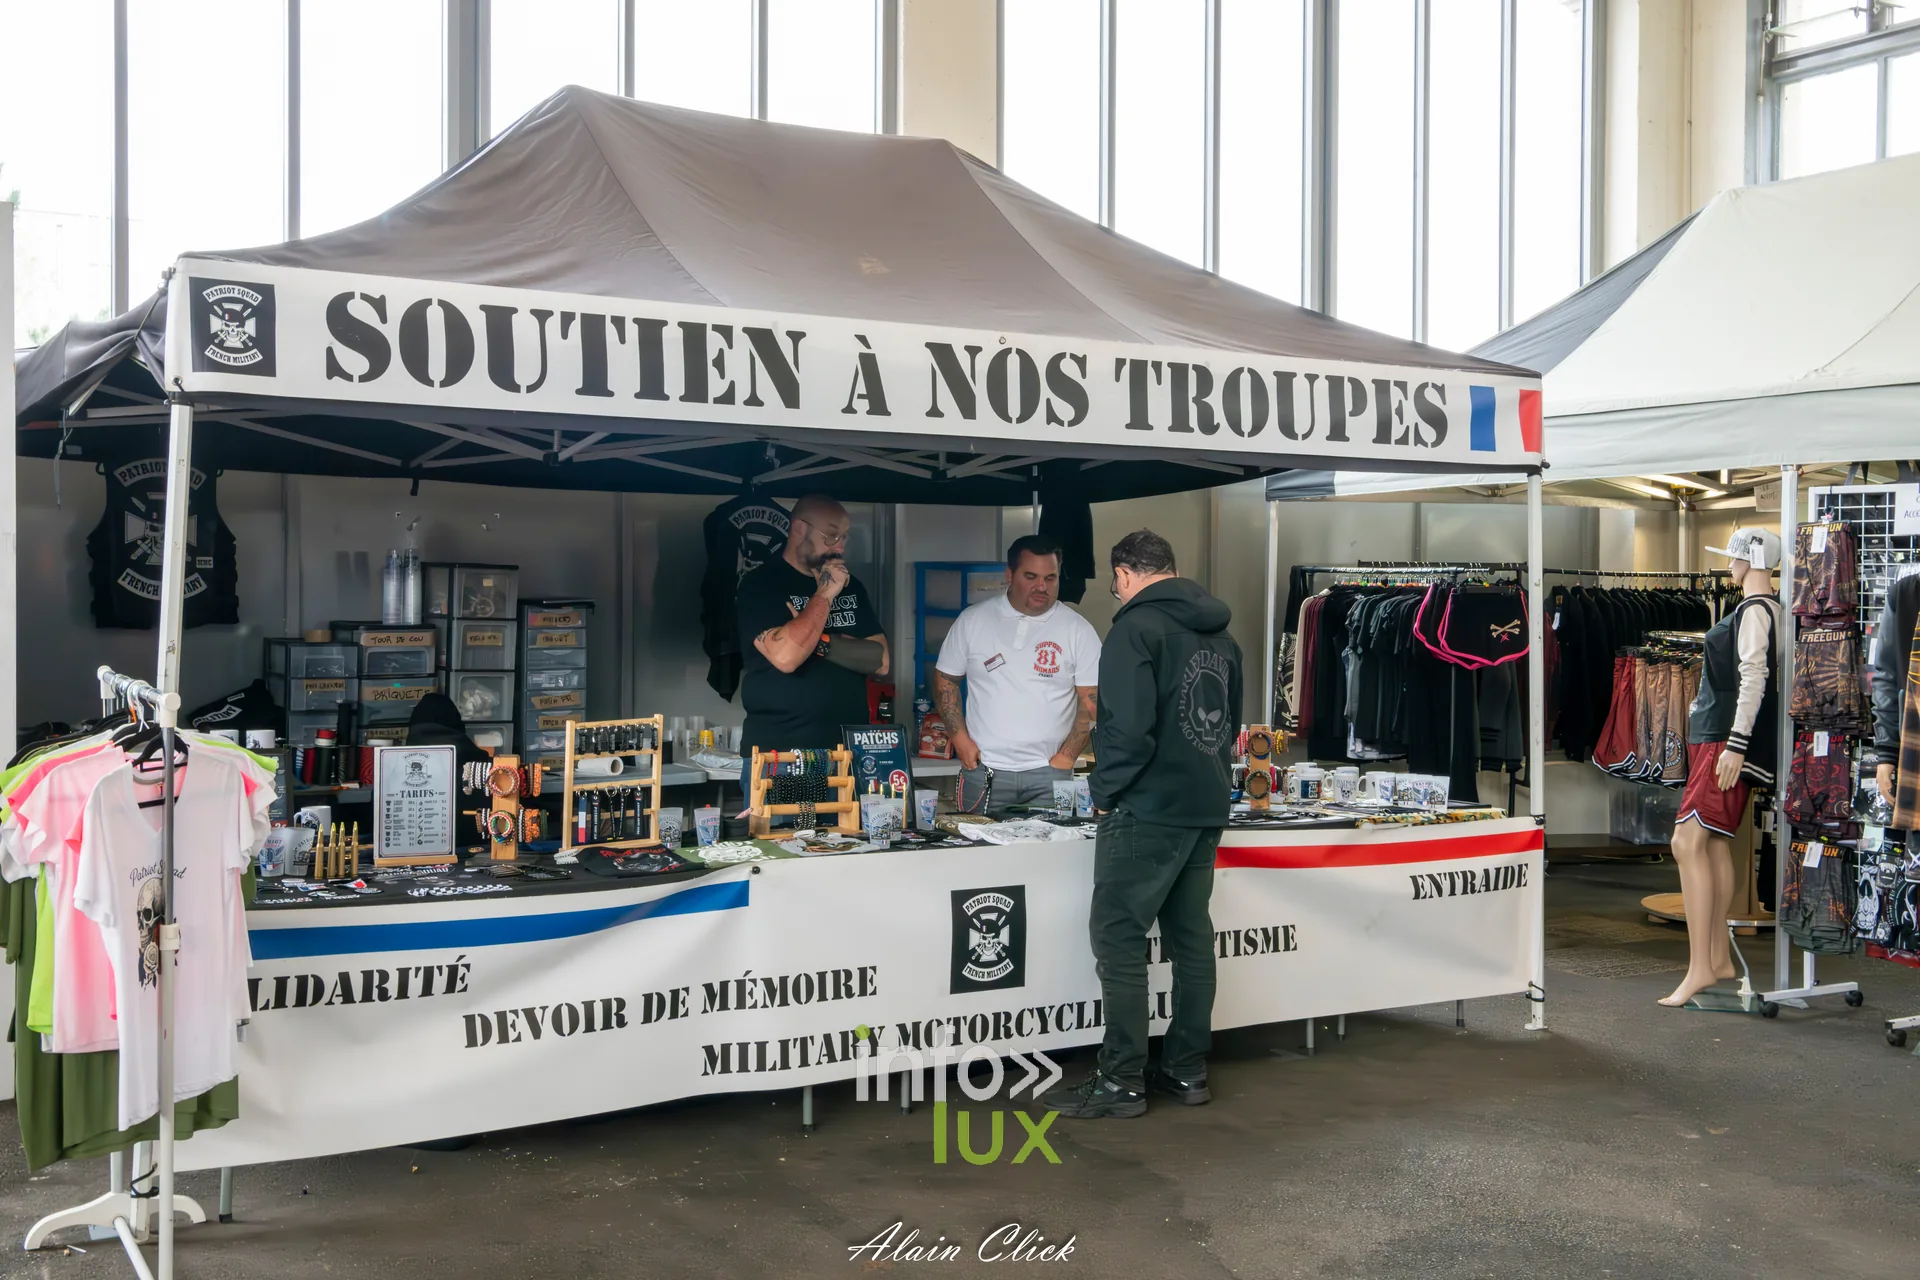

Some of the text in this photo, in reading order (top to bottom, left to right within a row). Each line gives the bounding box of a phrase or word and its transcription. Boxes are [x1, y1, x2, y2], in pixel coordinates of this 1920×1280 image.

[205, 286, 259, 303] PATRIOT SQUAD
[207, 346, 260, 364] FRENCH MILITARY
[325, 291, 1449, 449] SOUTIEN À NOS TROUPES
[733, 509, 791, 530] PATRIOT SQUA
[1800, 522, 1843, 535] FRUN
[121, 572, 160, 597] FRENCH
[789, 594, 858, 611] PAIOT
[370, 635, 392, 645] TOUR
[1801, 630, 1847, 643] FREEGUN
[1036, 649, 1058, 666] 81
[1033, 662, 1061, 675] NOMADS
[853, 731, 899, 746] PATCHS
[1799, 732, 1844, 743] FRUN
[892, 774, 906, 786] 5€
[399, 788, 436, 799] TARIFS
[1790, 842, 1839, 857] FRUN
[129, 862, 157, 888] Patriot
[1409, 862, 1529, 900] ENTRAIDE
[965, 895, 1012, 913] PATRIOT SQUAD
[964, 961, 1012, 980] FRENCH MILITARY
[247, 954, 471, 1012] LIDARITÉ
[462, 965, 878, 1049] DEVOIR DE MÉMOIRE
[701, 1024, 885, 1077] MILITARY
